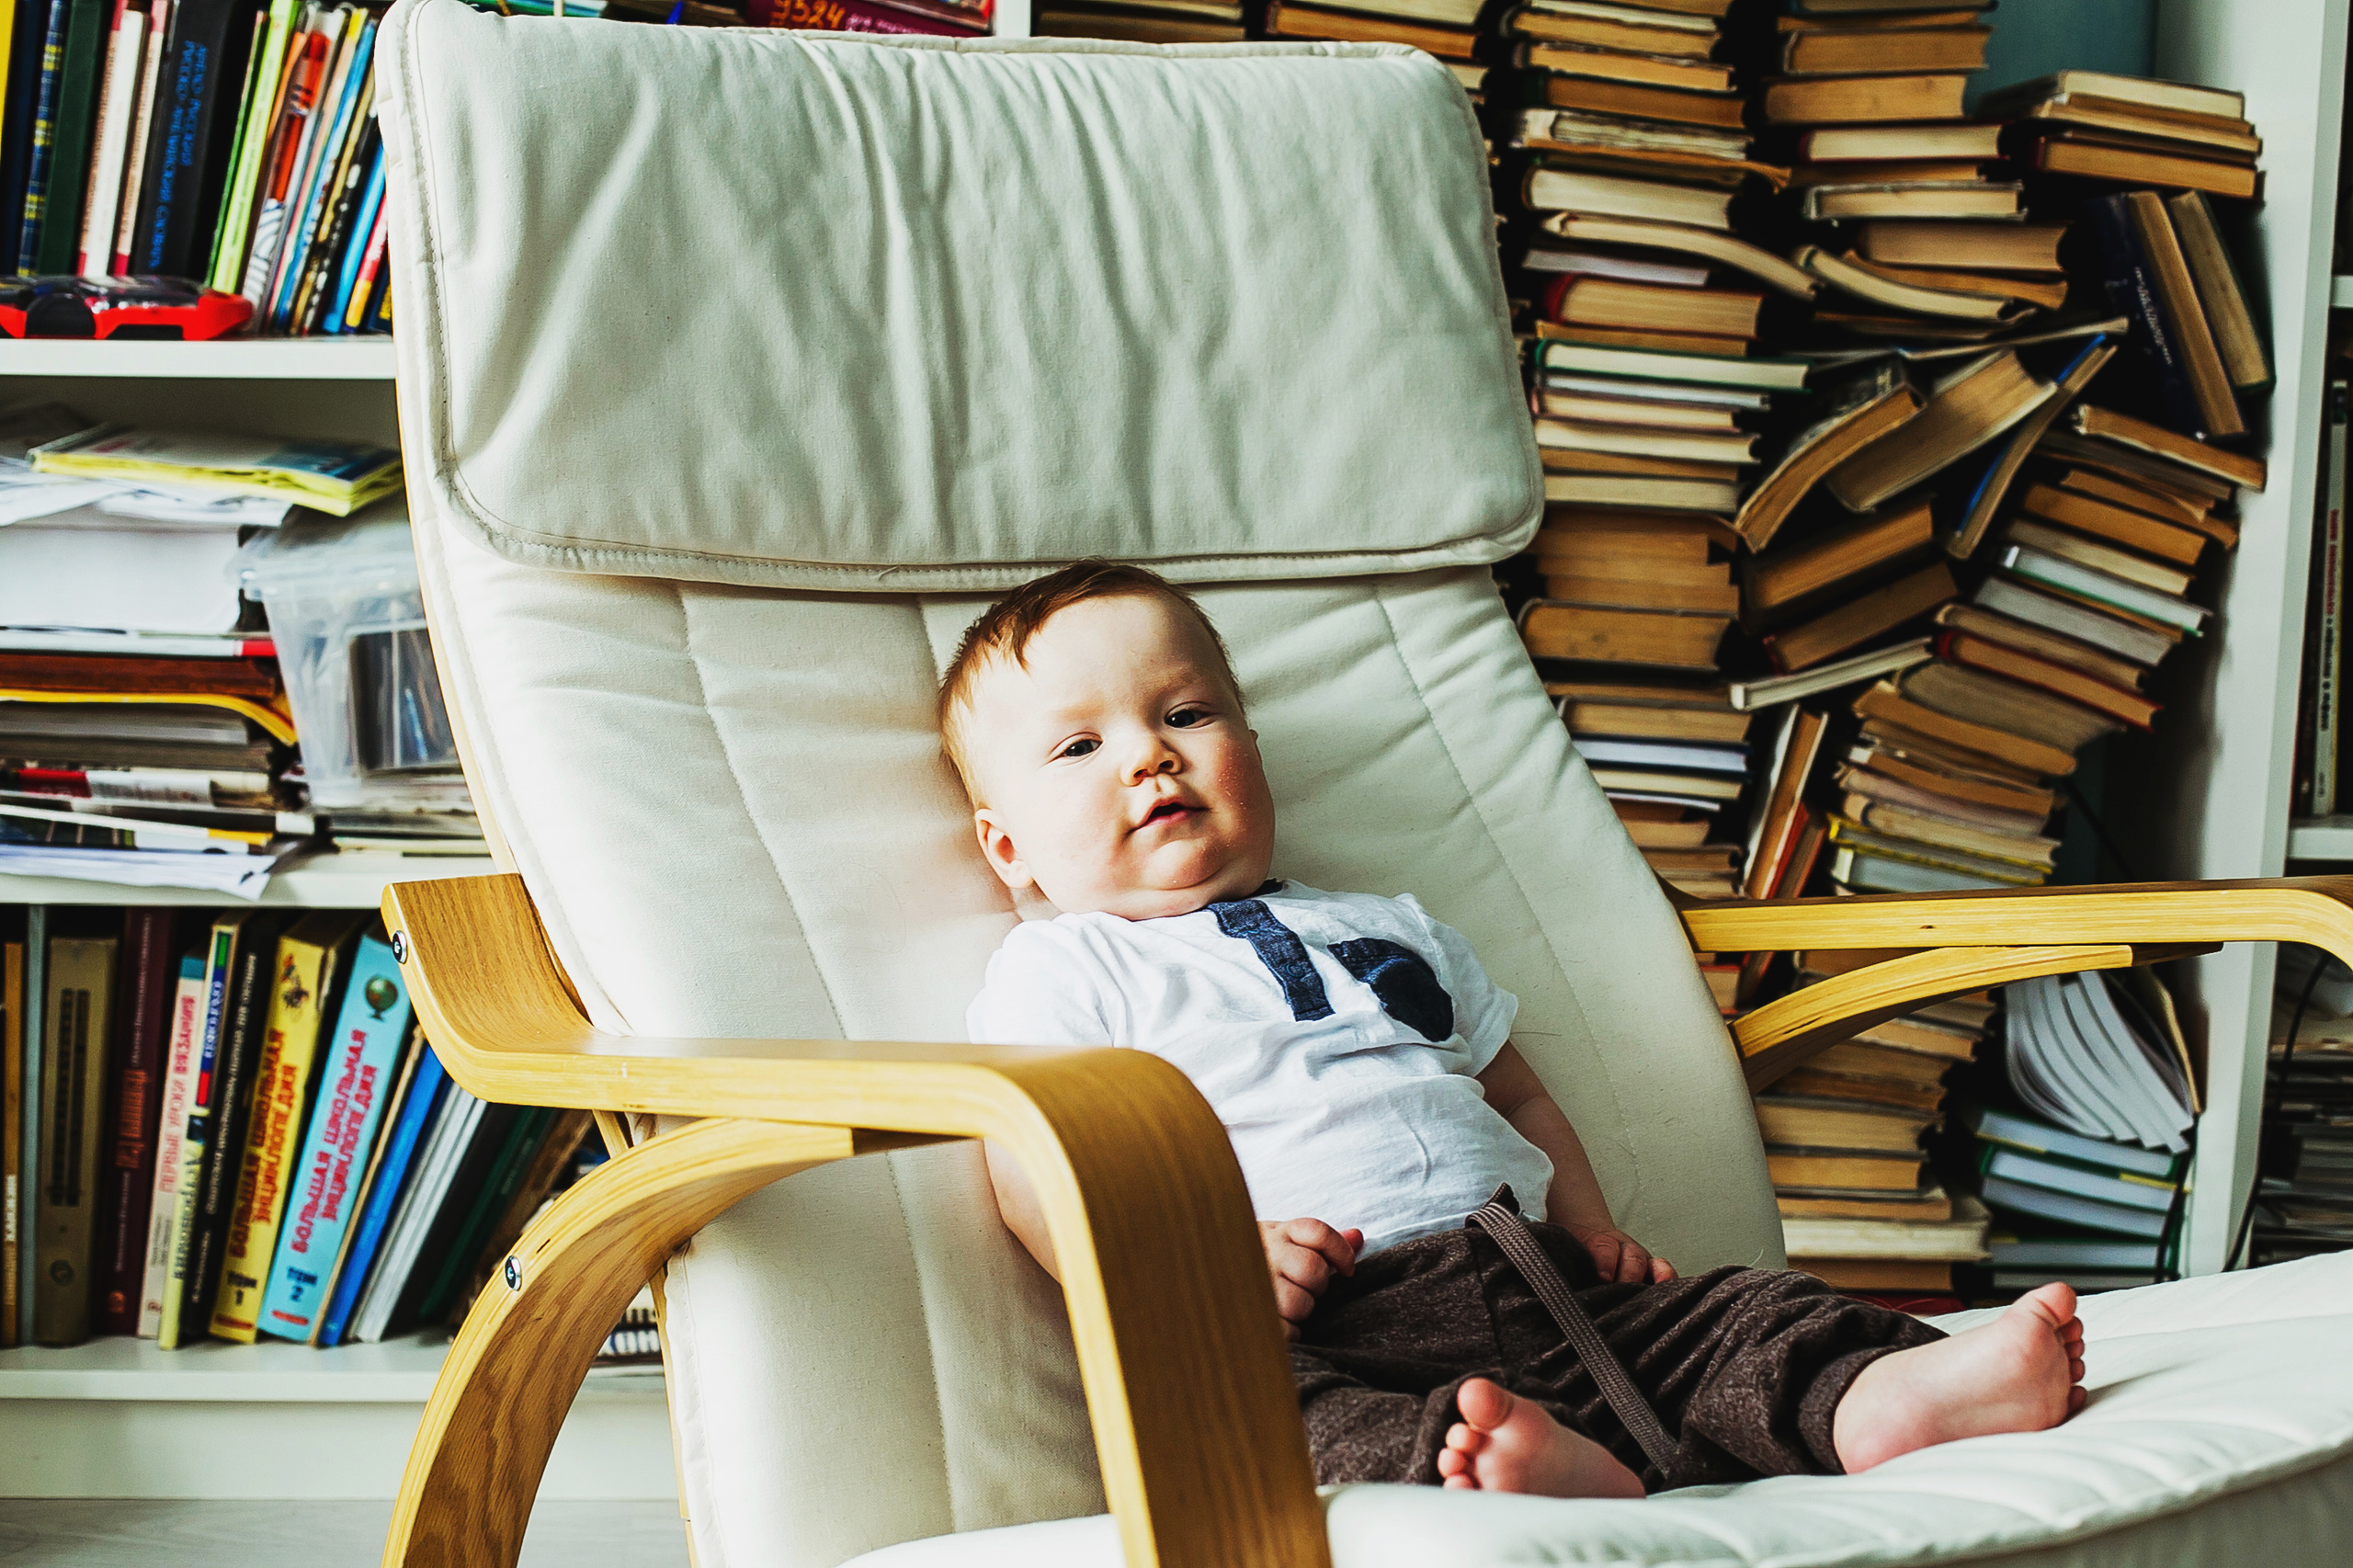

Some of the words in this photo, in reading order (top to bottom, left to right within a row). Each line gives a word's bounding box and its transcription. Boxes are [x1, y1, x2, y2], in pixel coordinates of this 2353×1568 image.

[159, 1133, 179, 1193] ПЕРВЫЕ
[173, 995, 195, 1074] ВЯЗАНИЯ
[230, 1153, 261, 1258] БОЛЬШАЯ
[250, 1027, 285, 1147] ШКОЛЬНАЯ
[254, 1063, 298, 1224] ЭНЦИКЛОПЕДИЯ
[290, 1150, 332, 1254] БОЛЬШАЯ
[323, 1028, 366, 1145] ШКОЛЬНАЯ
[320, 1063, 377, 1222] ЭНЦИКЛОПЕДИЯ
[235, 1290, 244, 1305] 1
[290, 1285, 303, 1302] 2
